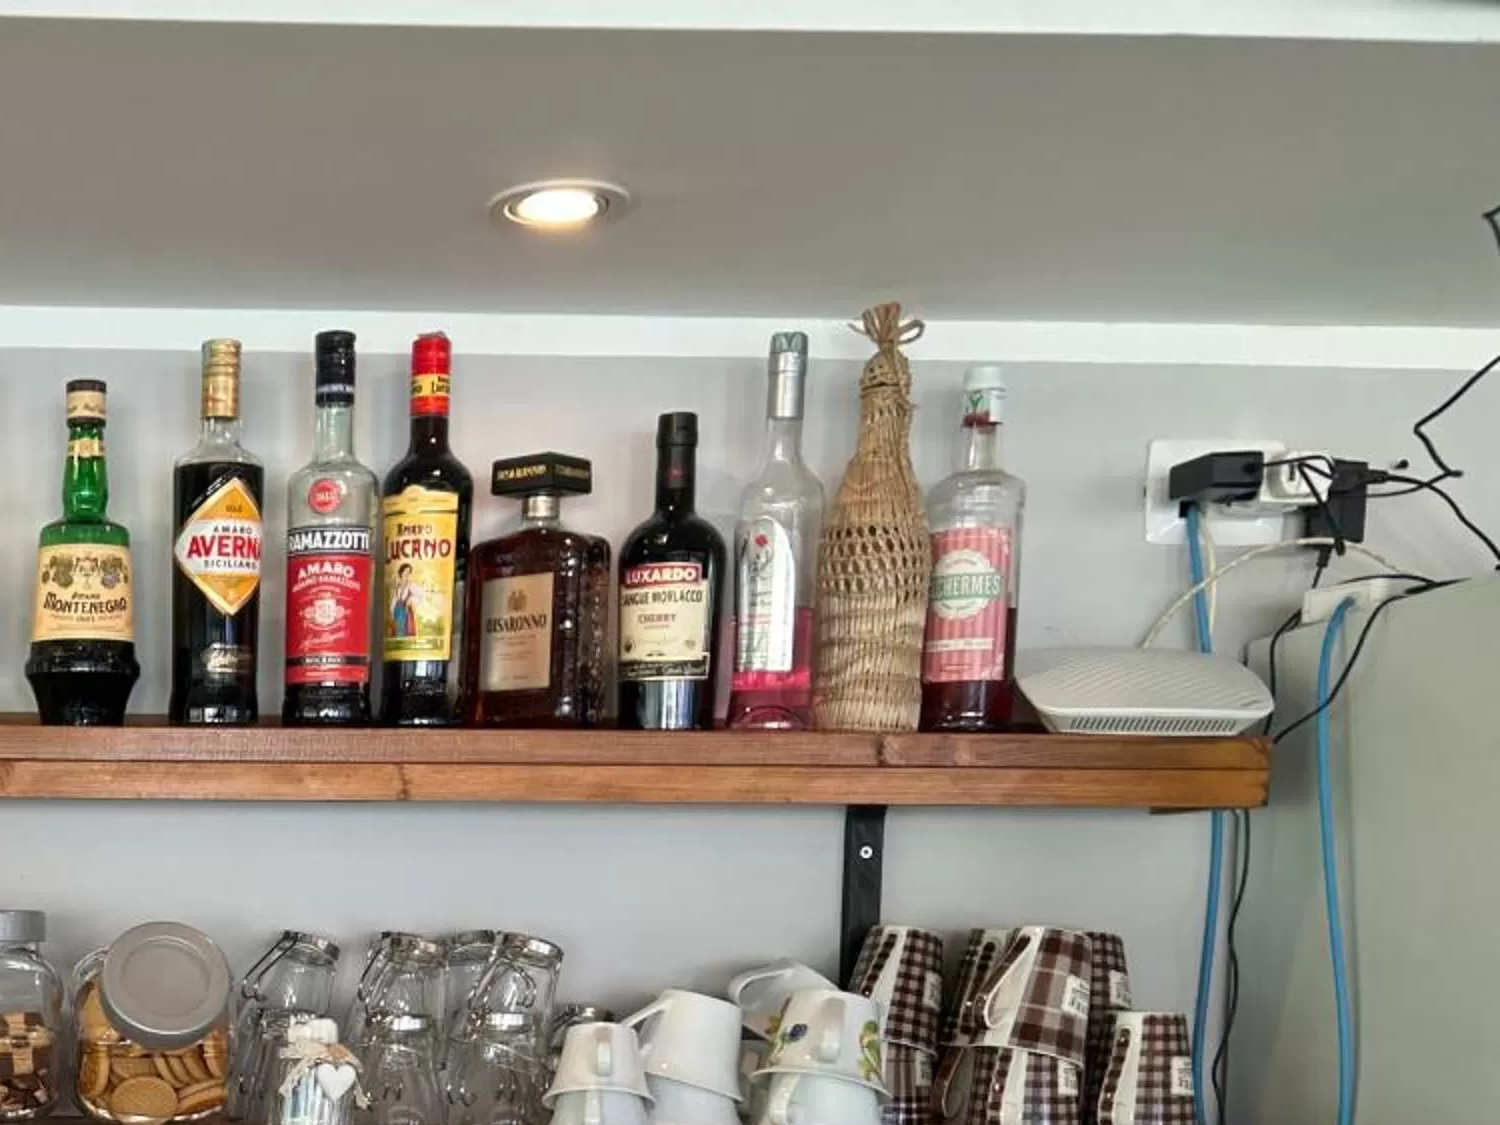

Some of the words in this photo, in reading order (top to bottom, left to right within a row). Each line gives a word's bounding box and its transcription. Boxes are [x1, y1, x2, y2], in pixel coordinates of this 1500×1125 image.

[213, 525, 254, 534] AMARO
[384, 537, 451, 563] LUCANO
[298, 561, 355, 580] AMARO
[626, 566, 697, 585] LUXARDO
[43, 591, 127, 614] MONTENEGRO
